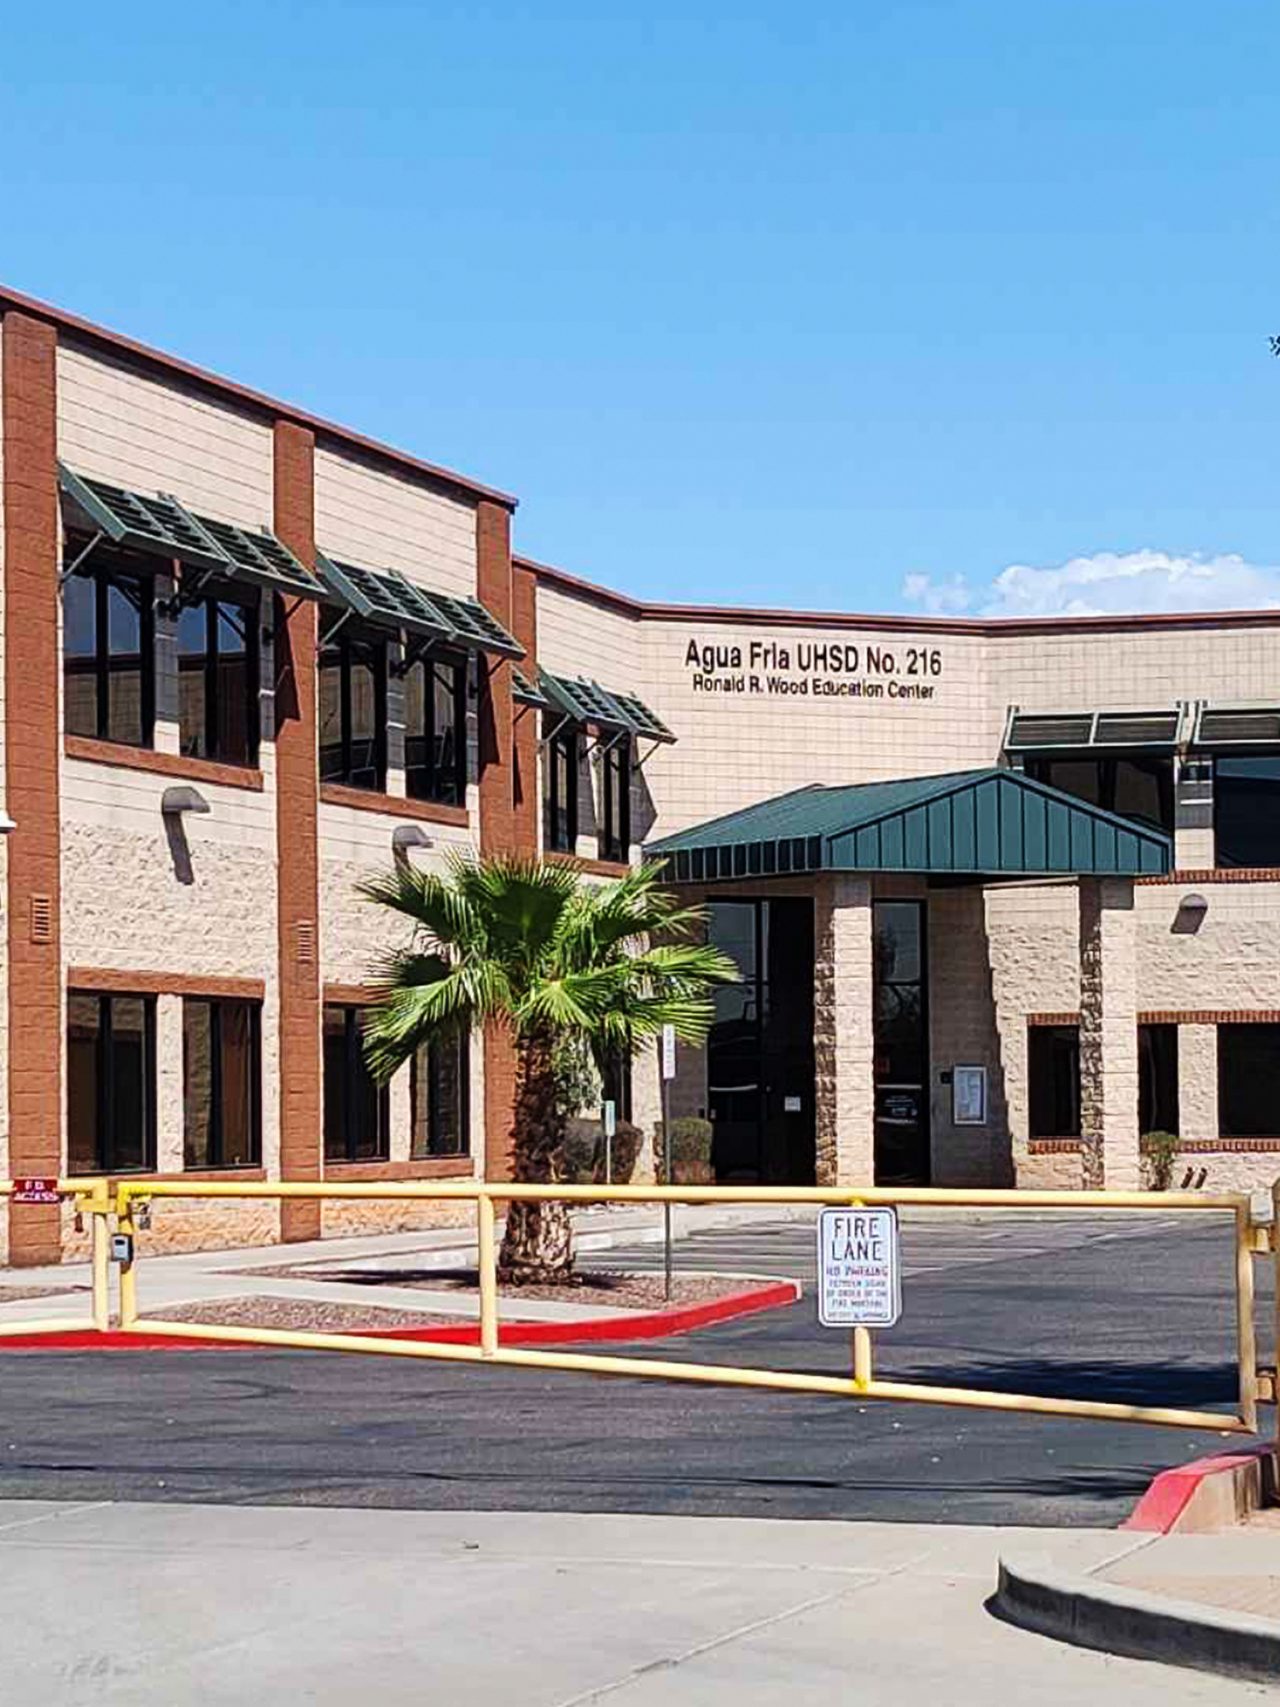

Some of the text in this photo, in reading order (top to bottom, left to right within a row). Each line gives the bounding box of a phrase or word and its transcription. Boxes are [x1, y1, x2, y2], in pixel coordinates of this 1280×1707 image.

[685, 639, 742, 675] Agua
[797, 643, 859, 673] UHSD
[866, 646, 901, 674] No.
[906, 648, 942, 676] 216
[693, 673, 934, 699] Ronald R. Wood Education Center
[834, 1217, 880, 1238] FIRE
[832, 1240, 883, 1261] LANE
